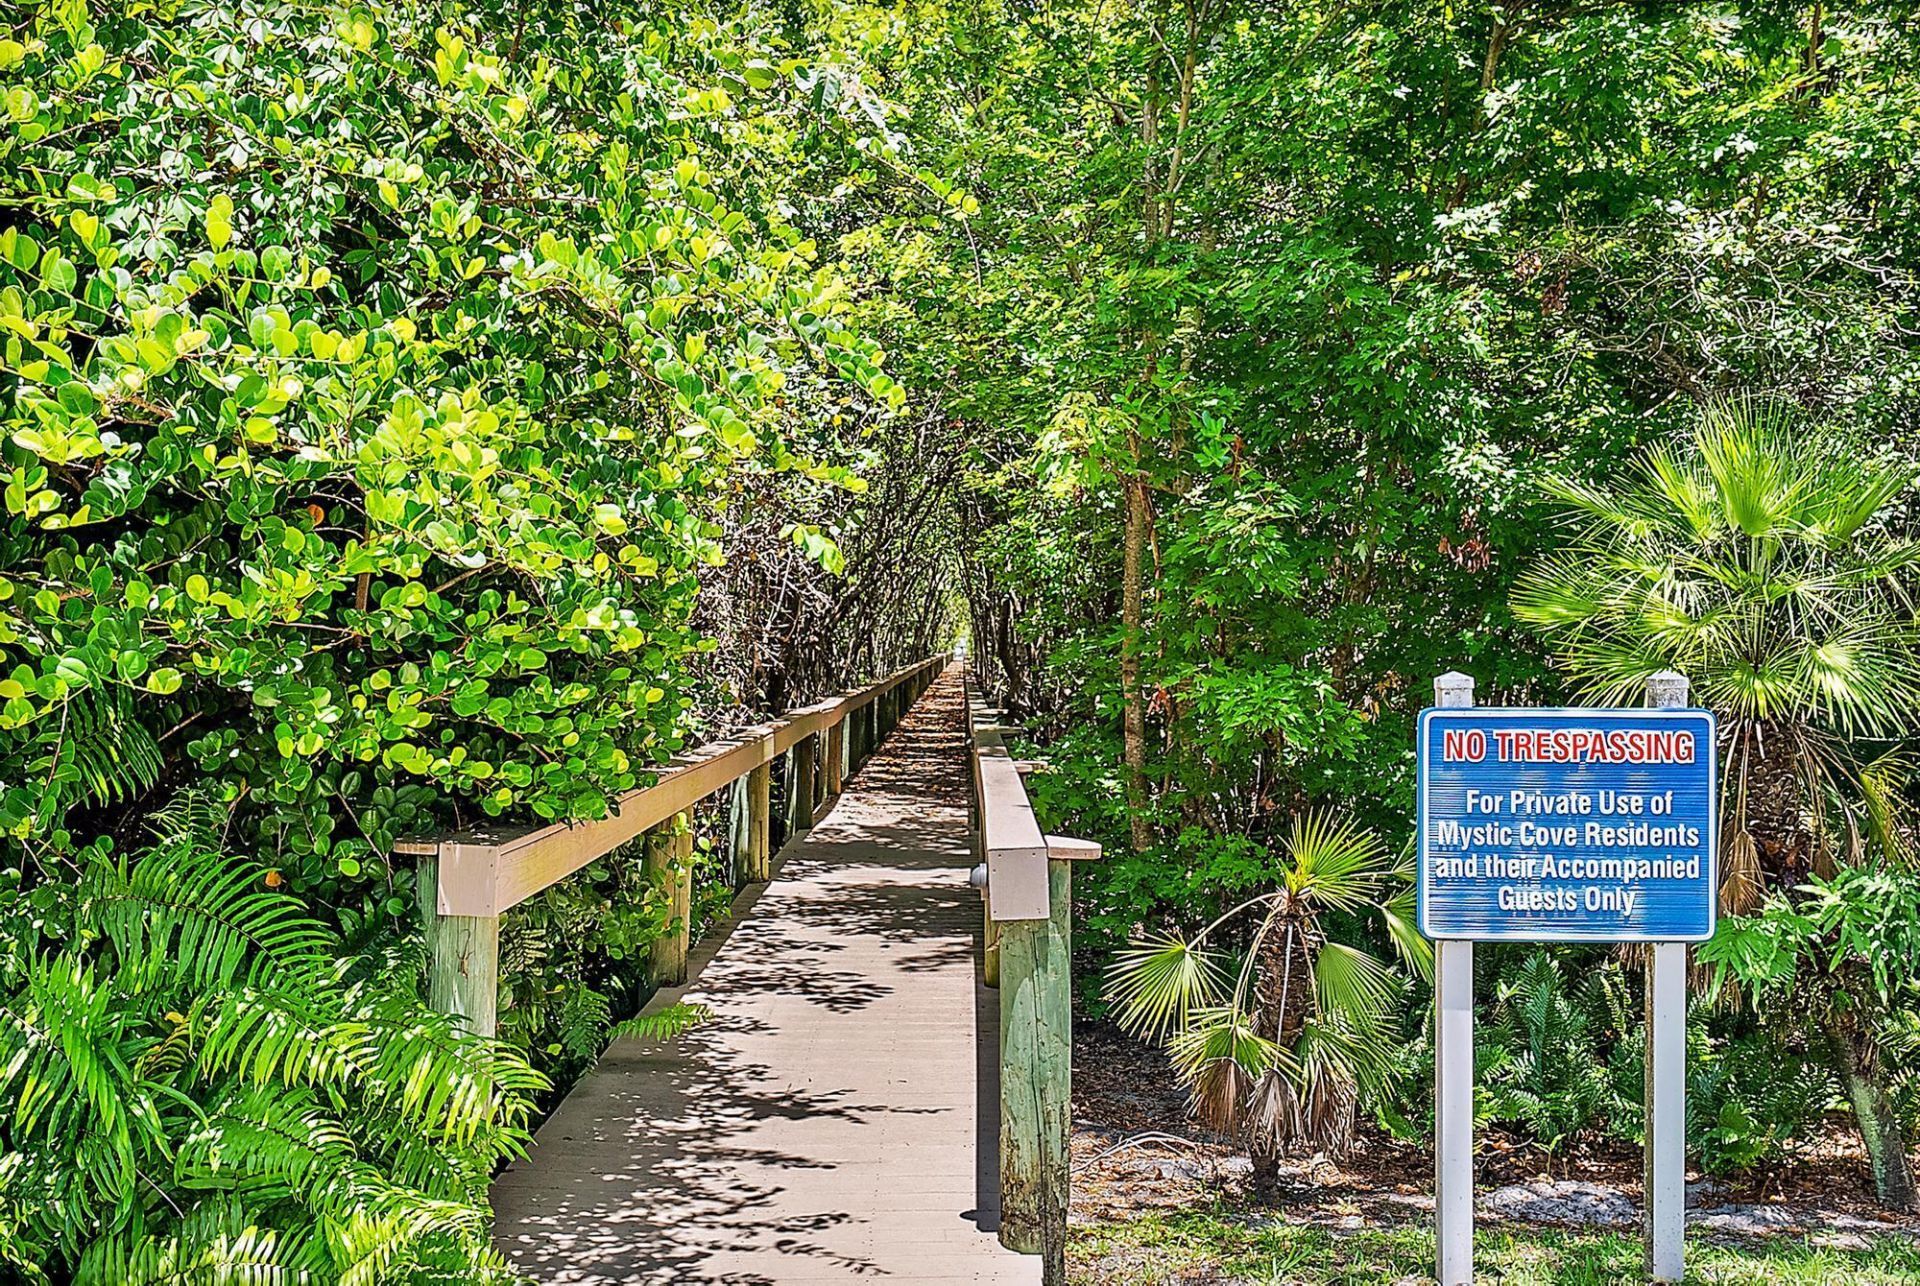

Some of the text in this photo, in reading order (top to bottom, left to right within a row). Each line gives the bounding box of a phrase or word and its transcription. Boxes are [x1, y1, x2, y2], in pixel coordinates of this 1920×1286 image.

[1444, 729, 1695, 764] NO TRESPASSING
[1466, 790, 1672, 815] For Private Use of
[1438, 822, 1699, 850] Mystic Cove Residents
[1436, 855, 1699, 883] and their Accompanied
[1499, 886, 1635, 916] Guests Only
